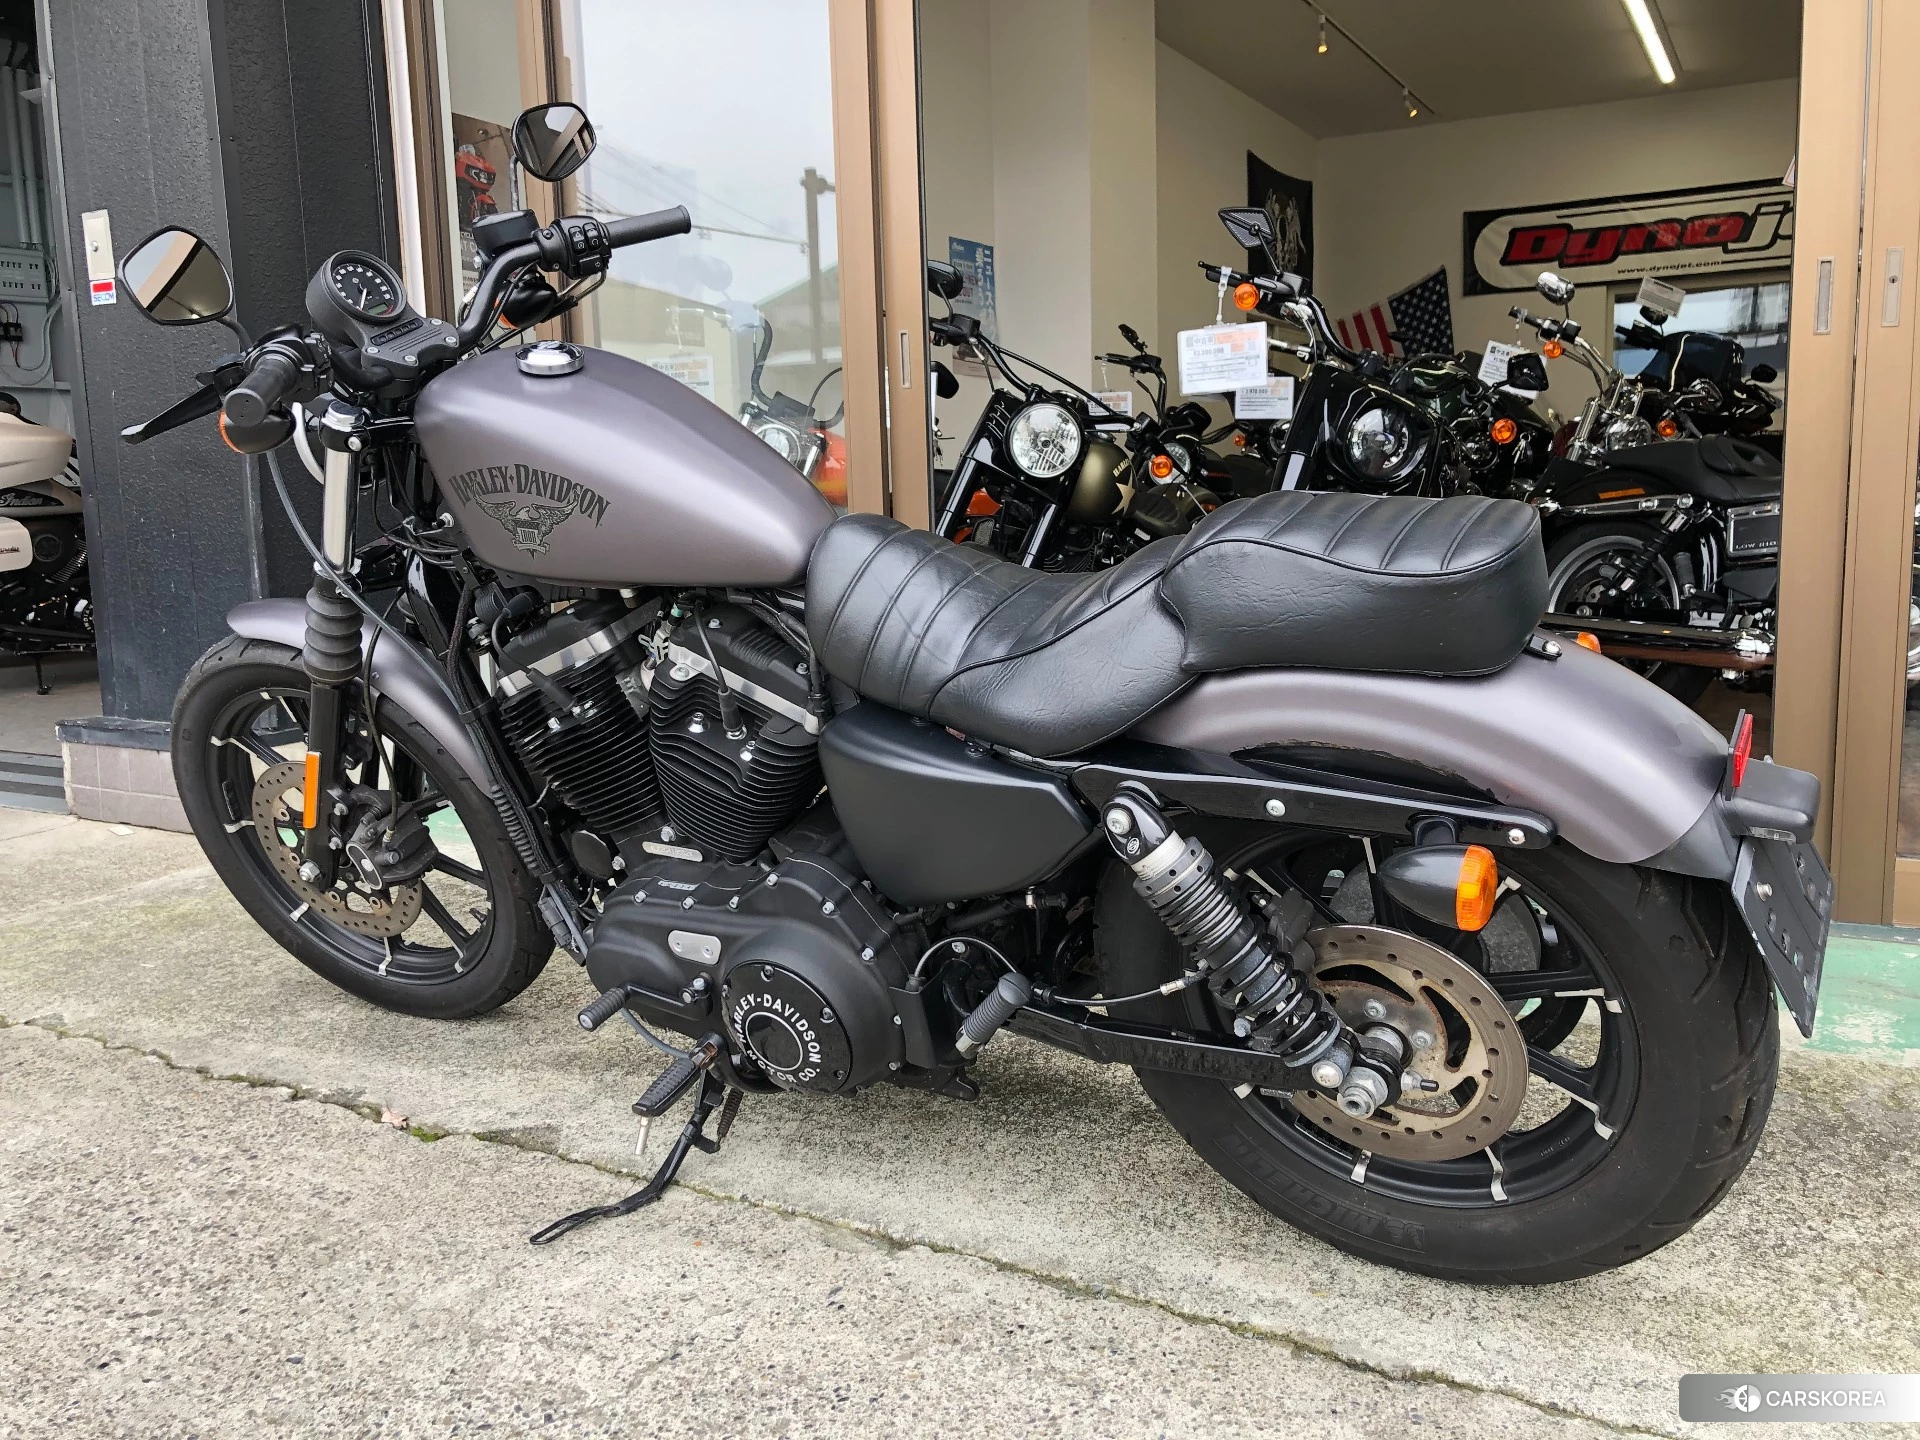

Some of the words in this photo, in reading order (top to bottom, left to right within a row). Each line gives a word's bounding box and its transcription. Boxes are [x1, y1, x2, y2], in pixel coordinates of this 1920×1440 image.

[1617, 260, 1720, 274] www.dynojet.com
[93, 292, 115, 302] SECOM
[733, 993, 822, 1063] HARLEY-DAVIDSON
[747, 1049, 798, 1083] MOTOR
[798, 1067, 821, 1082] CO.
